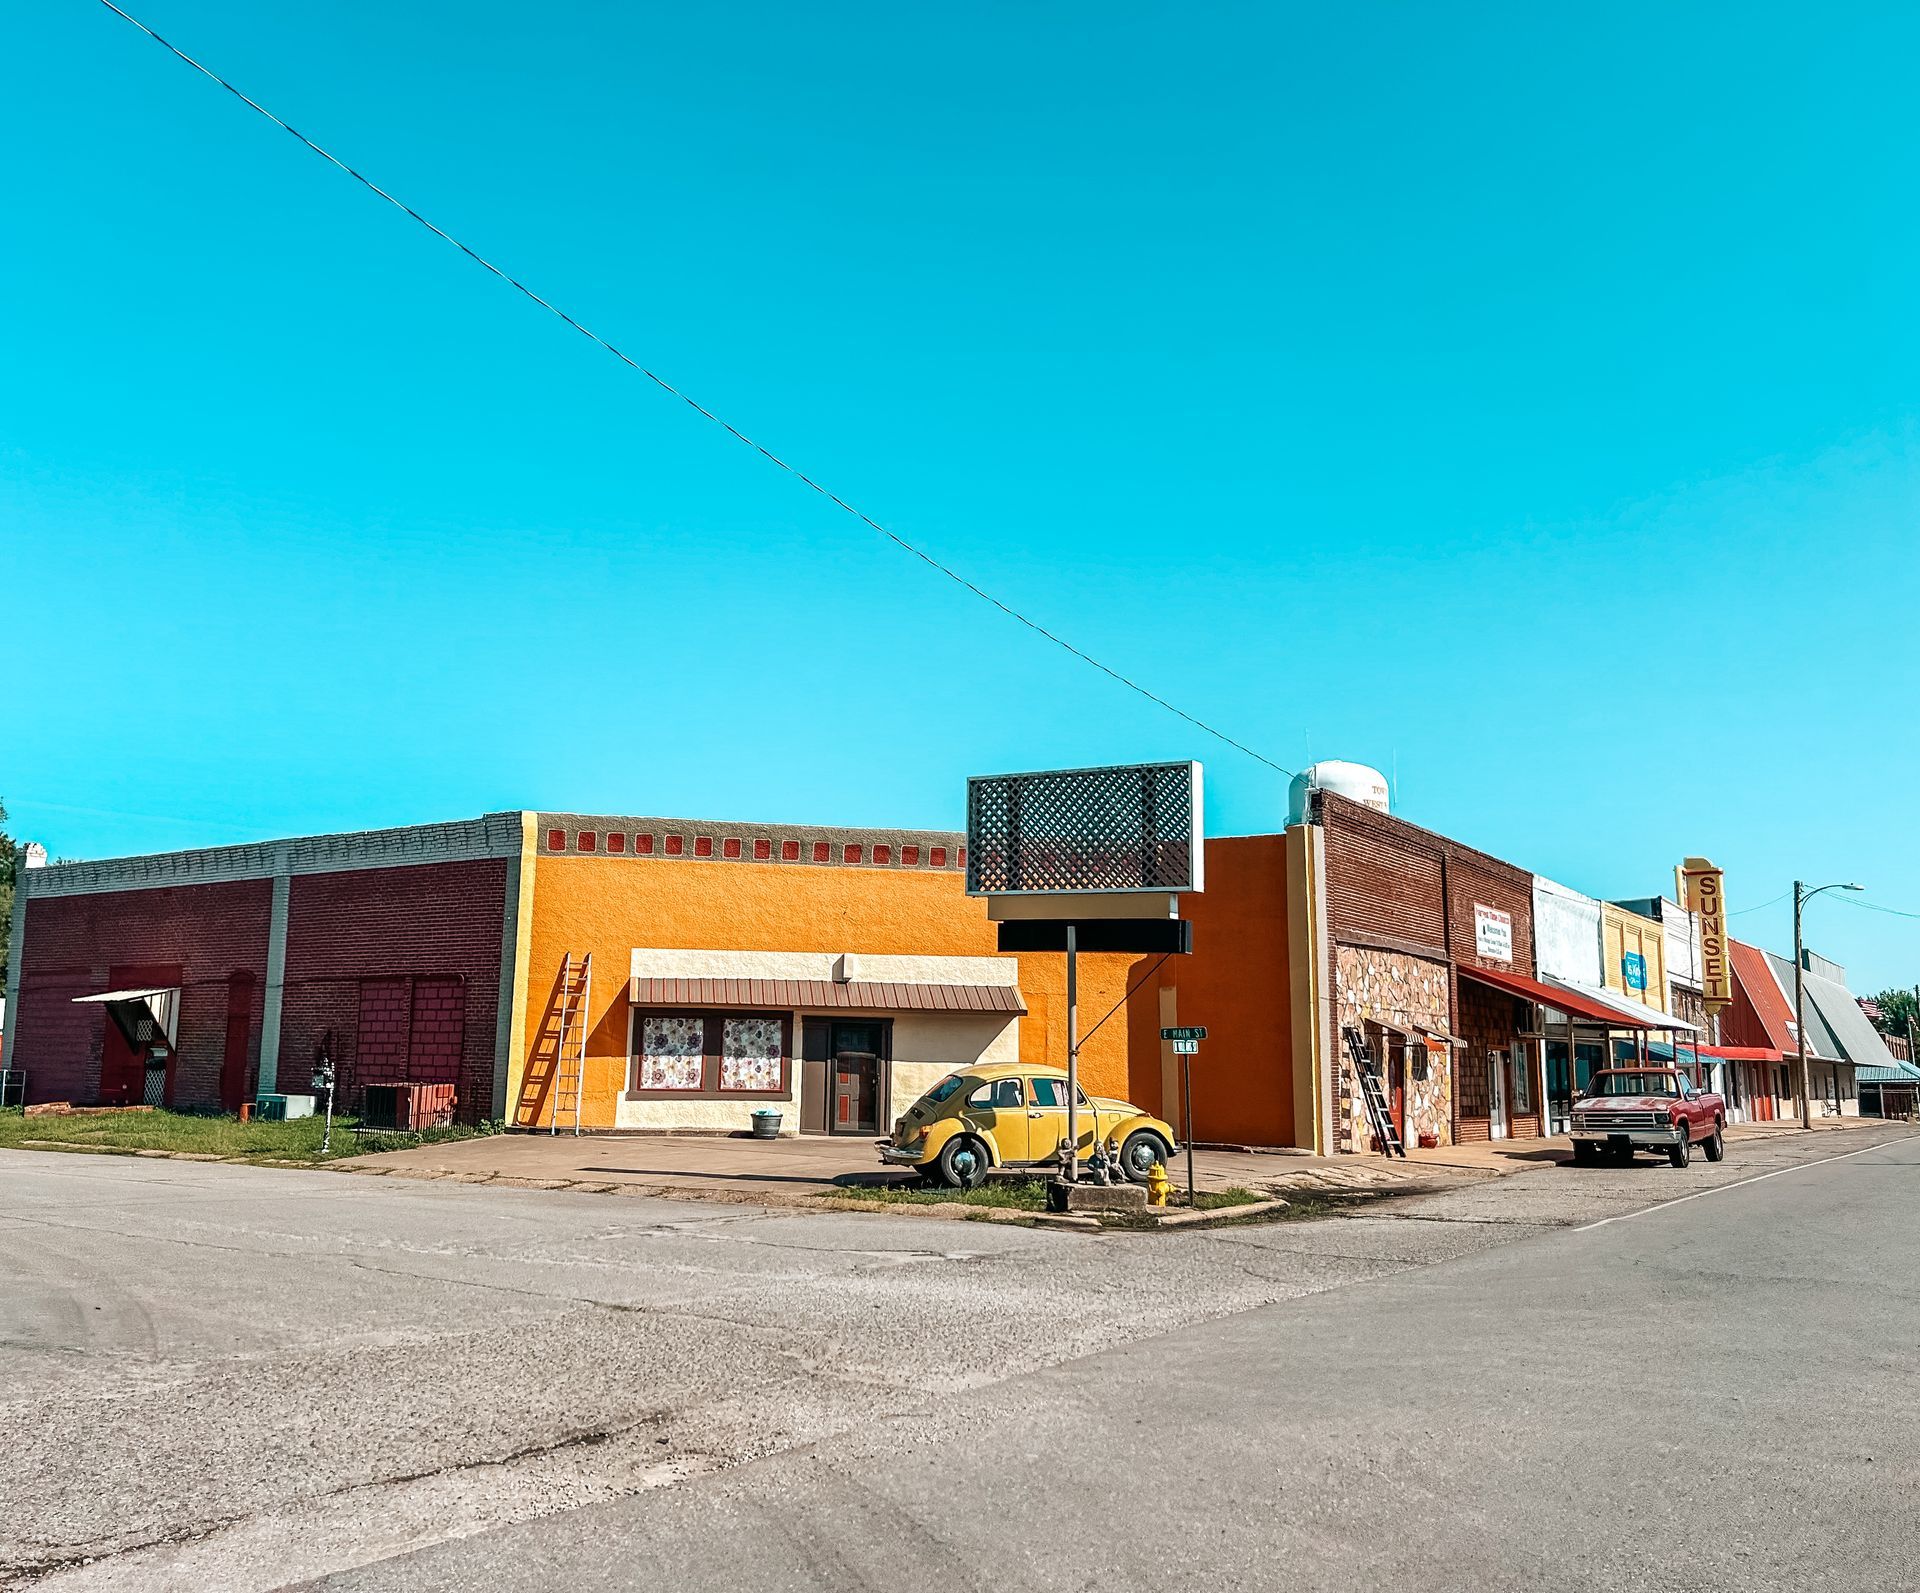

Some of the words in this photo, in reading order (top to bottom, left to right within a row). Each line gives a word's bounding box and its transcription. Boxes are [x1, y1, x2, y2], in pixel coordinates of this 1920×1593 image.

[1700, 876, 1722, 996] SUNSET
[1163, 1029, 1168, 1039] E
[1172, 1029, 1191, 1039] MAIN
[1194, 1028, 1203, 1038] ST
